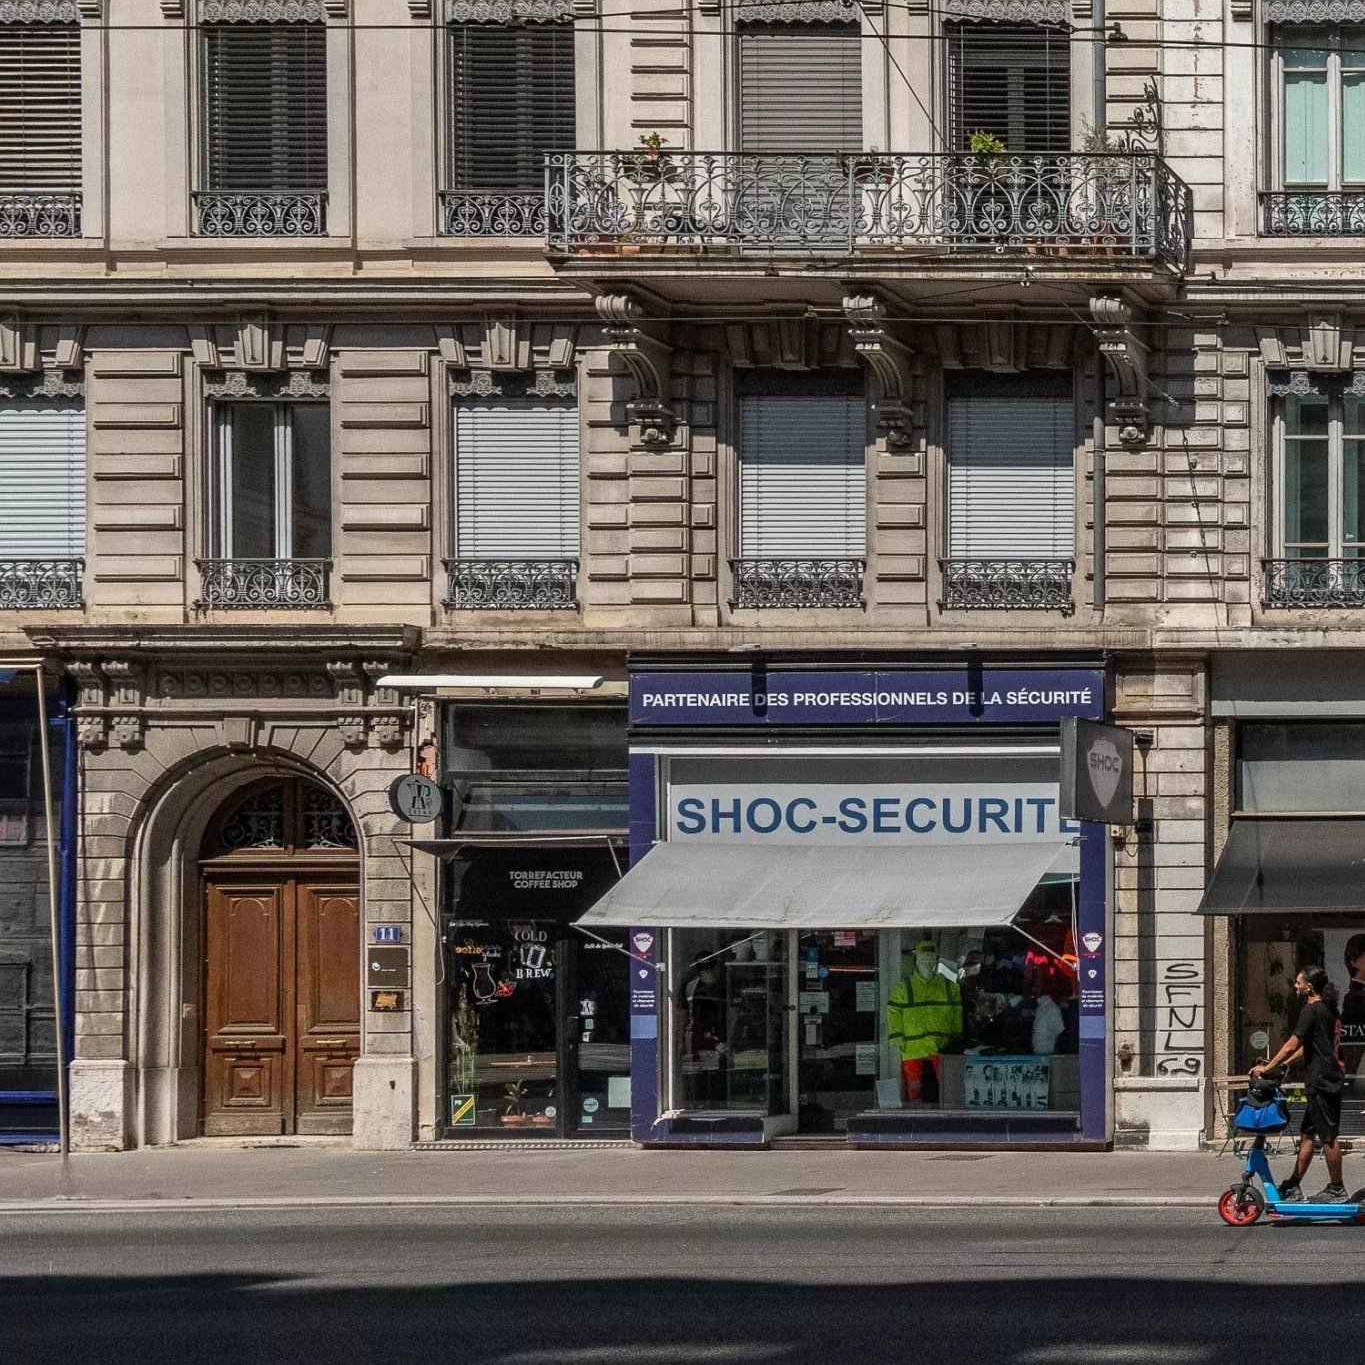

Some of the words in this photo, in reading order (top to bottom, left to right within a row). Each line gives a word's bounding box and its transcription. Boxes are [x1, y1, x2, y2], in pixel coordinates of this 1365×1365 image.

[642, 693, 750, 707] PARTENAIRE
[754, 692, 789, 706] DES
[793, 691, 948, 706] PROFESSIONNELS
[952, 691, 976, 705] DE
[980, 691, 1002, 705] LA
[1006, 688, 1092, 705] SÉCURITÉ
[1089, 751, 1120, 774] SHOC
[676, 796, 1080, 834] SHOC-SECURIT
[509, 870, 583, 880] TORREFACTEUR
[514, 880, 551, 888] COFFEE
[552, 880, 578, 888] SHOP
[379, 927, 395, 940] 11
